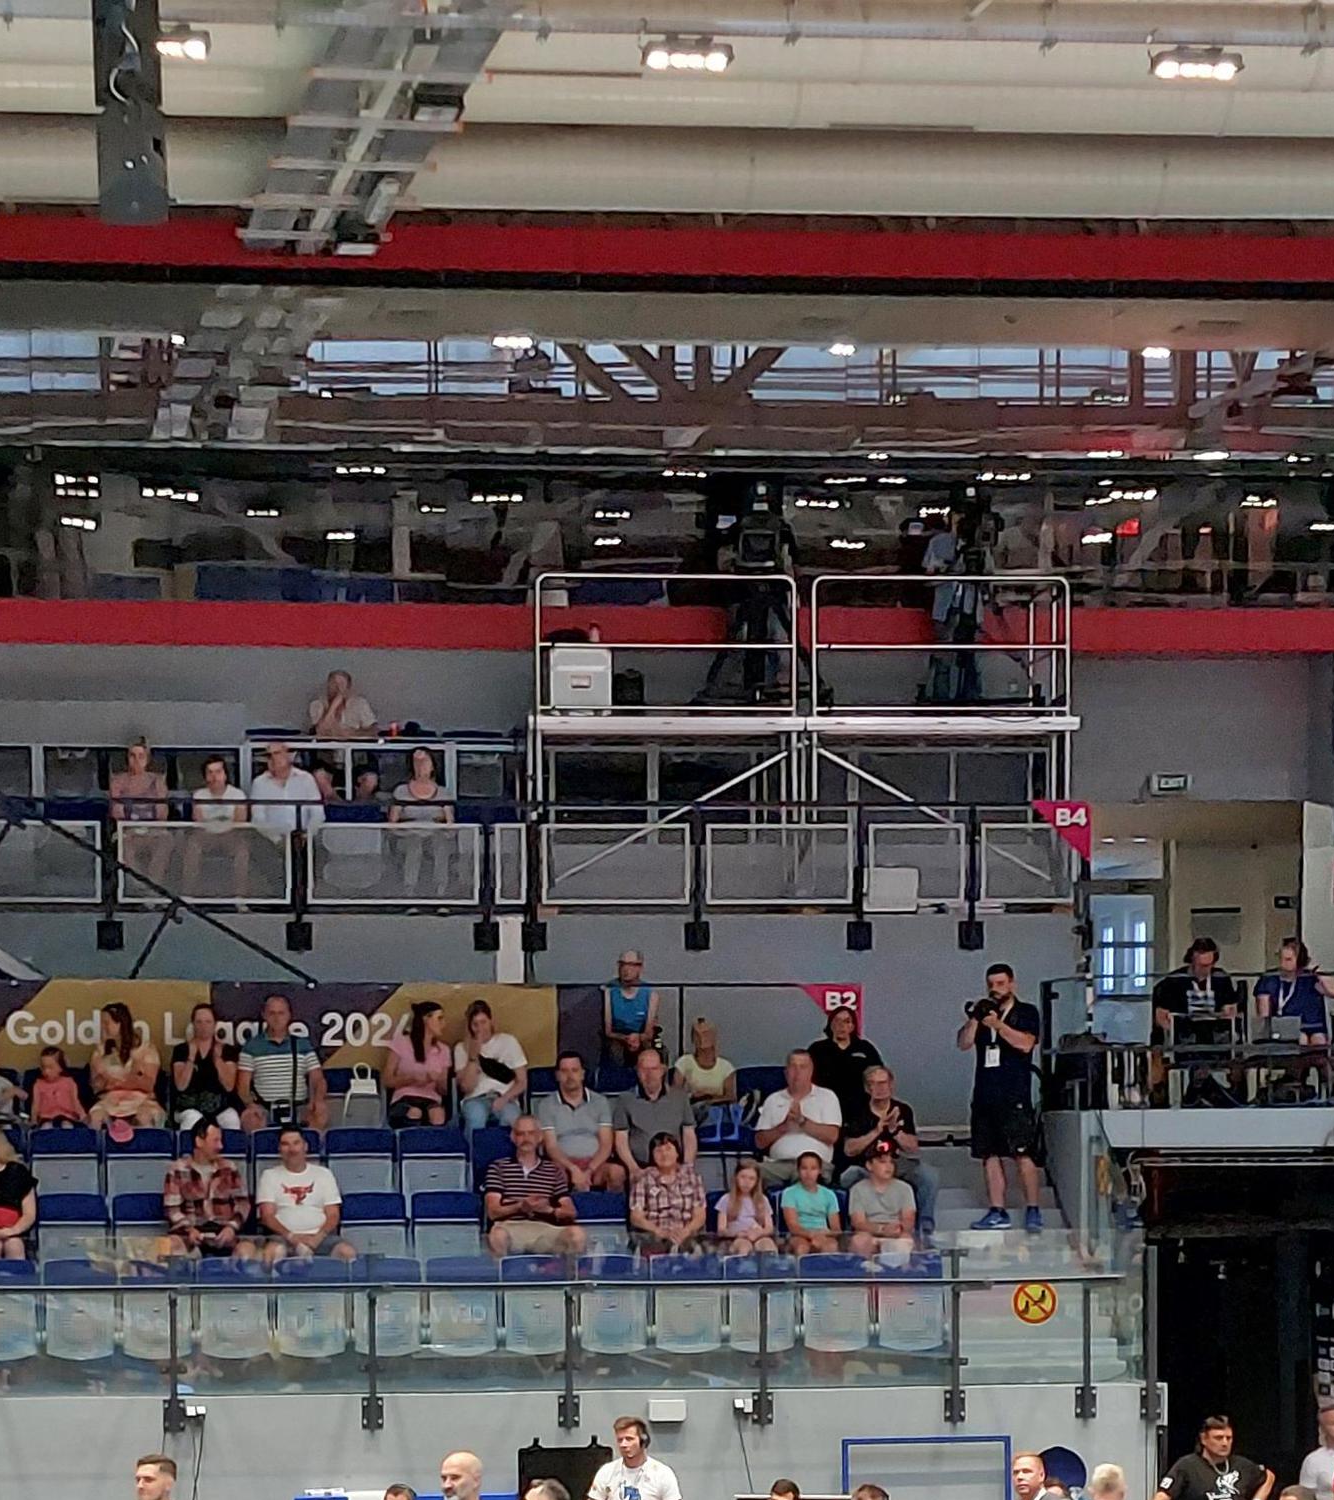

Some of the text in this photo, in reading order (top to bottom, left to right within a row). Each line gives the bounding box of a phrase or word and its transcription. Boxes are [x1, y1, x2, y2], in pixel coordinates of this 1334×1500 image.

[1055, 807, 1088, 826] B4
[825, 991, 857, 1011] B2
[5, 1009, 151, 1046] Goldn
